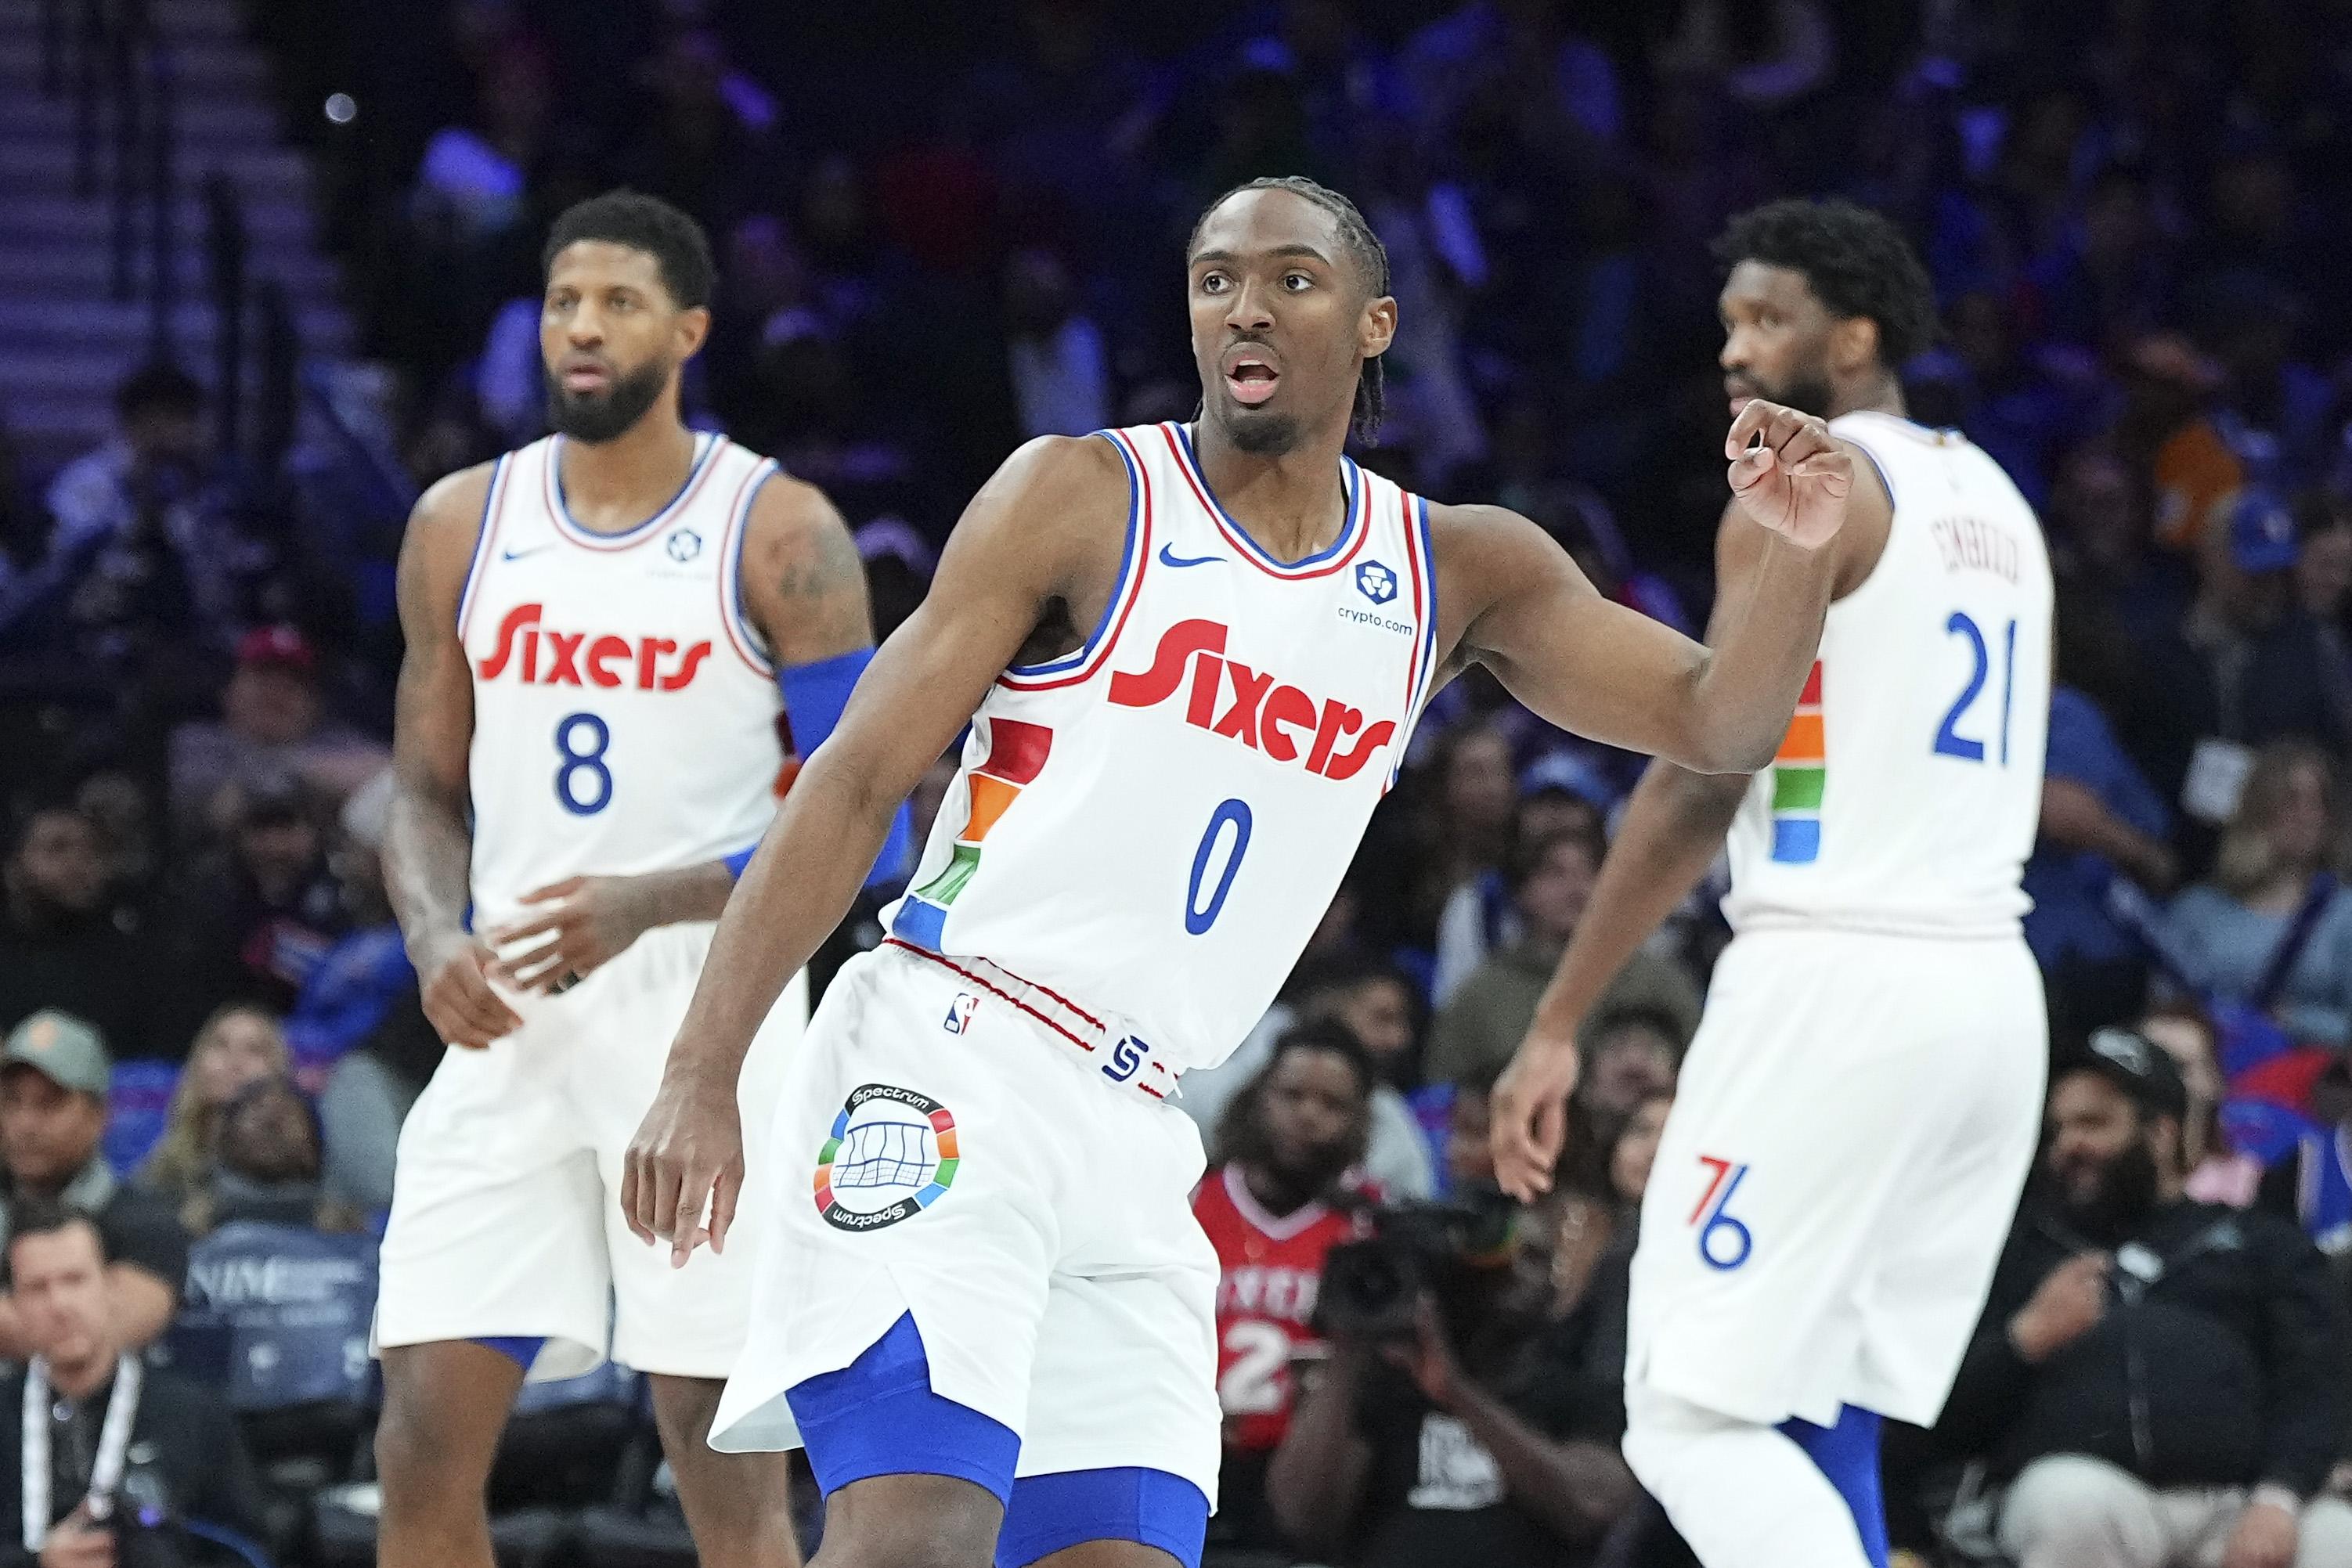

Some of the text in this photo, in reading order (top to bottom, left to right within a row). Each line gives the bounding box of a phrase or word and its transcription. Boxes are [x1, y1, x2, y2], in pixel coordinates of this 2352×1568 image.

[479, 603, 712, 692] Sixers
[1338, 607, 1413, 636] crypto.com
[1106, 618, 1397, 781] Sixers
[1933, 611, 2017, 766] 21
[555, 712, 614, 817] 8
[1185, 798, 1254, 936] 0
[851, 1087, 930, 1110] Spectrum
[832, 1202, 906, 1229] Spectrum
[1690, 1155, 1753, 1272] 76
